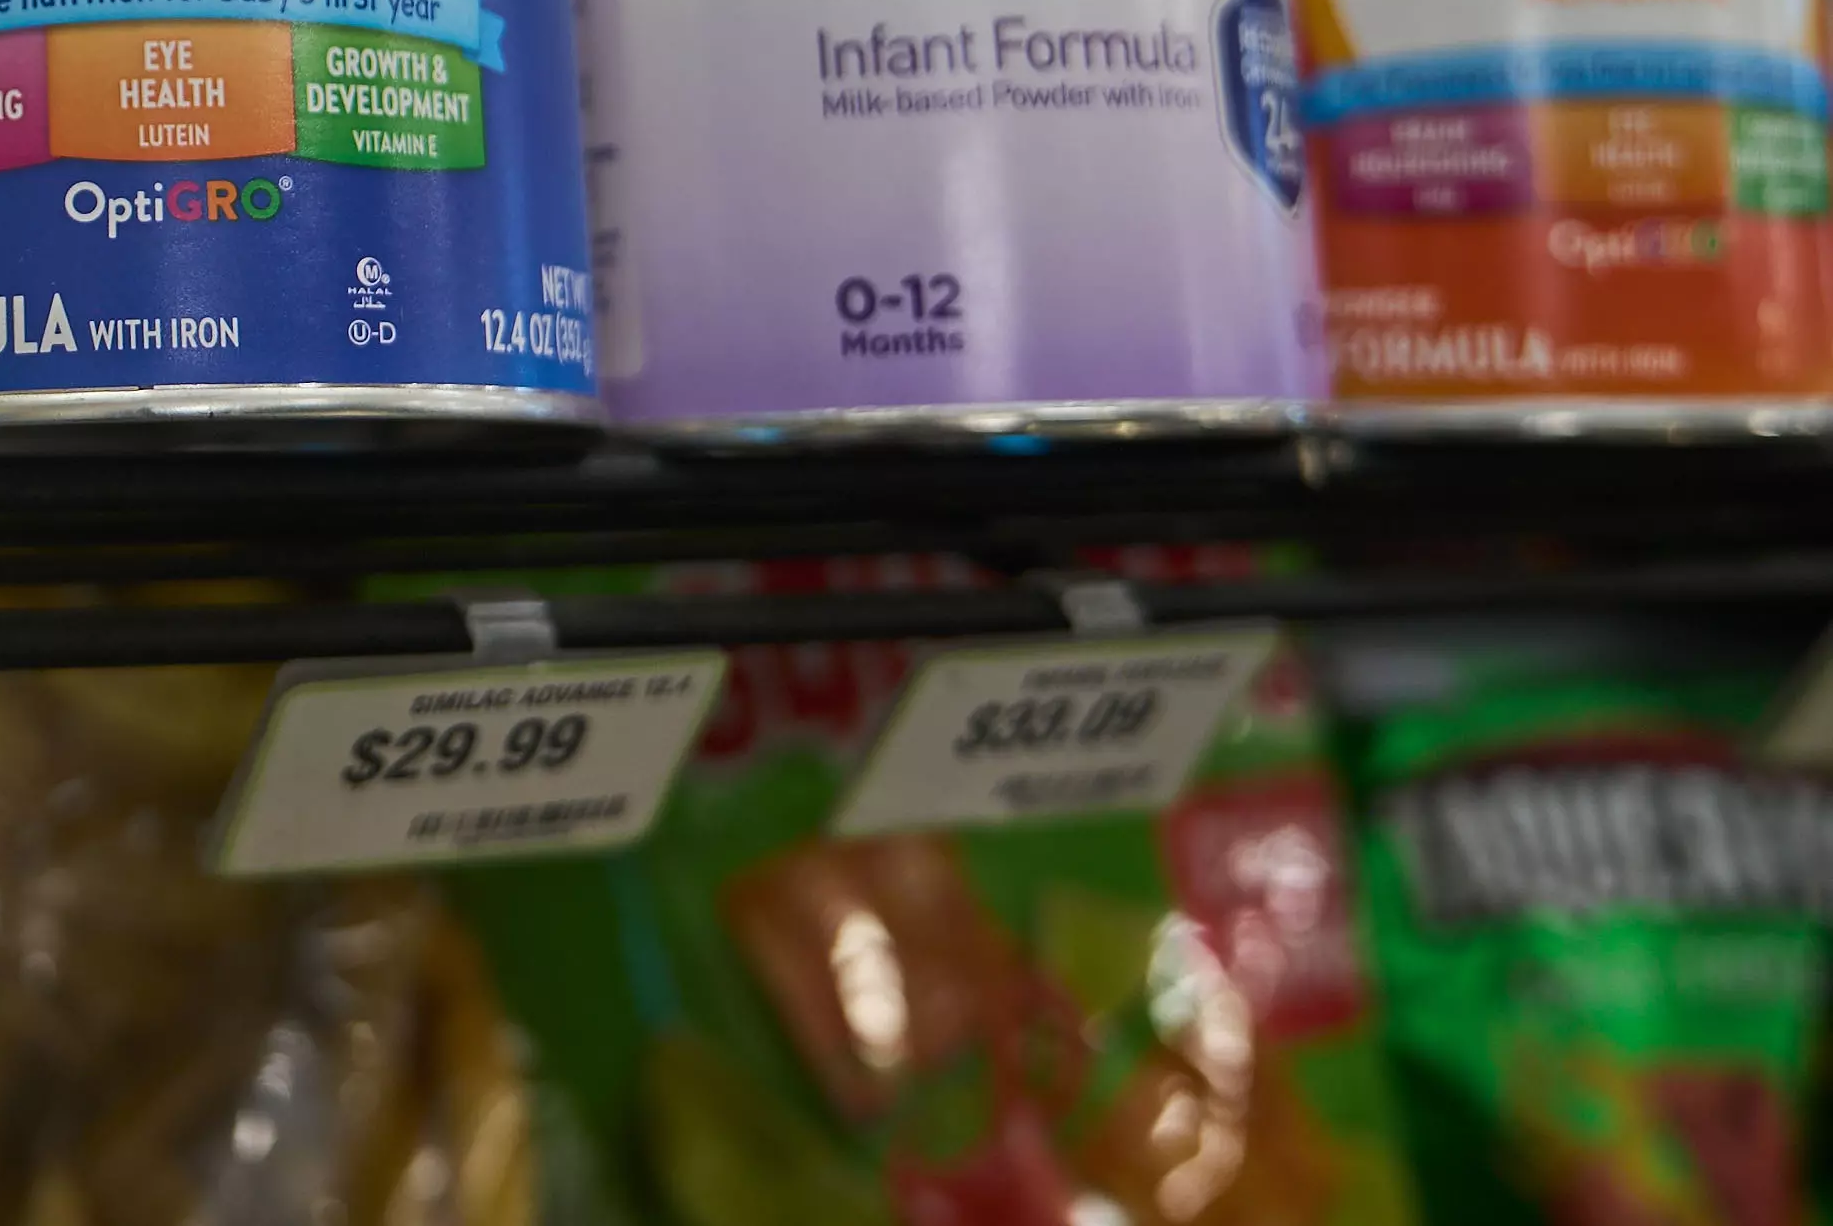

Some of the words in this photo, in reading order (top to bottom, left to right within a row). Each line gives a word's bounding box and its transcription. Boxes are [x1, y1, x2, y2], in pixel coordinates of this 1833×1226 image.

[142, 39, 195, 72] EYE
[326, 45, 417, 83] GROWTH
[430, 54, 450, 85] &
[818, 24, 976, 82] Infant
[992, 15, 1199, 75] Formula
[119, 77, 227, 110] HEALTH
[305, 81, 471, 124] DEVELOPMENT
[821, 86, 984, 120] Milk-based
[992, 80, 1097, 109] Powder
[1101, 81, 1154, 109] with
[138, 123, 211, 149] LUTEIN
[351, 128, 425, 155] VITAMIN
[427, 133, 439, 158] E
[347, 287, 394, 296] HALAL
[541, 264, 571, 309] NET
[835, 274, 963, 324] 0-12
[88, 317, 163, 352] WITH
[169, 316, 241, 351] IRON
[480, 308, 527, 354] 12.4
[529, 312, 555, 358] OZ
[840, 329, 965, 359] Months
[409, 686, 514, 716] SIMILAC
[517, 676, 636, 706] ADVANCE
[342, 712, 590, 788] $29.99
